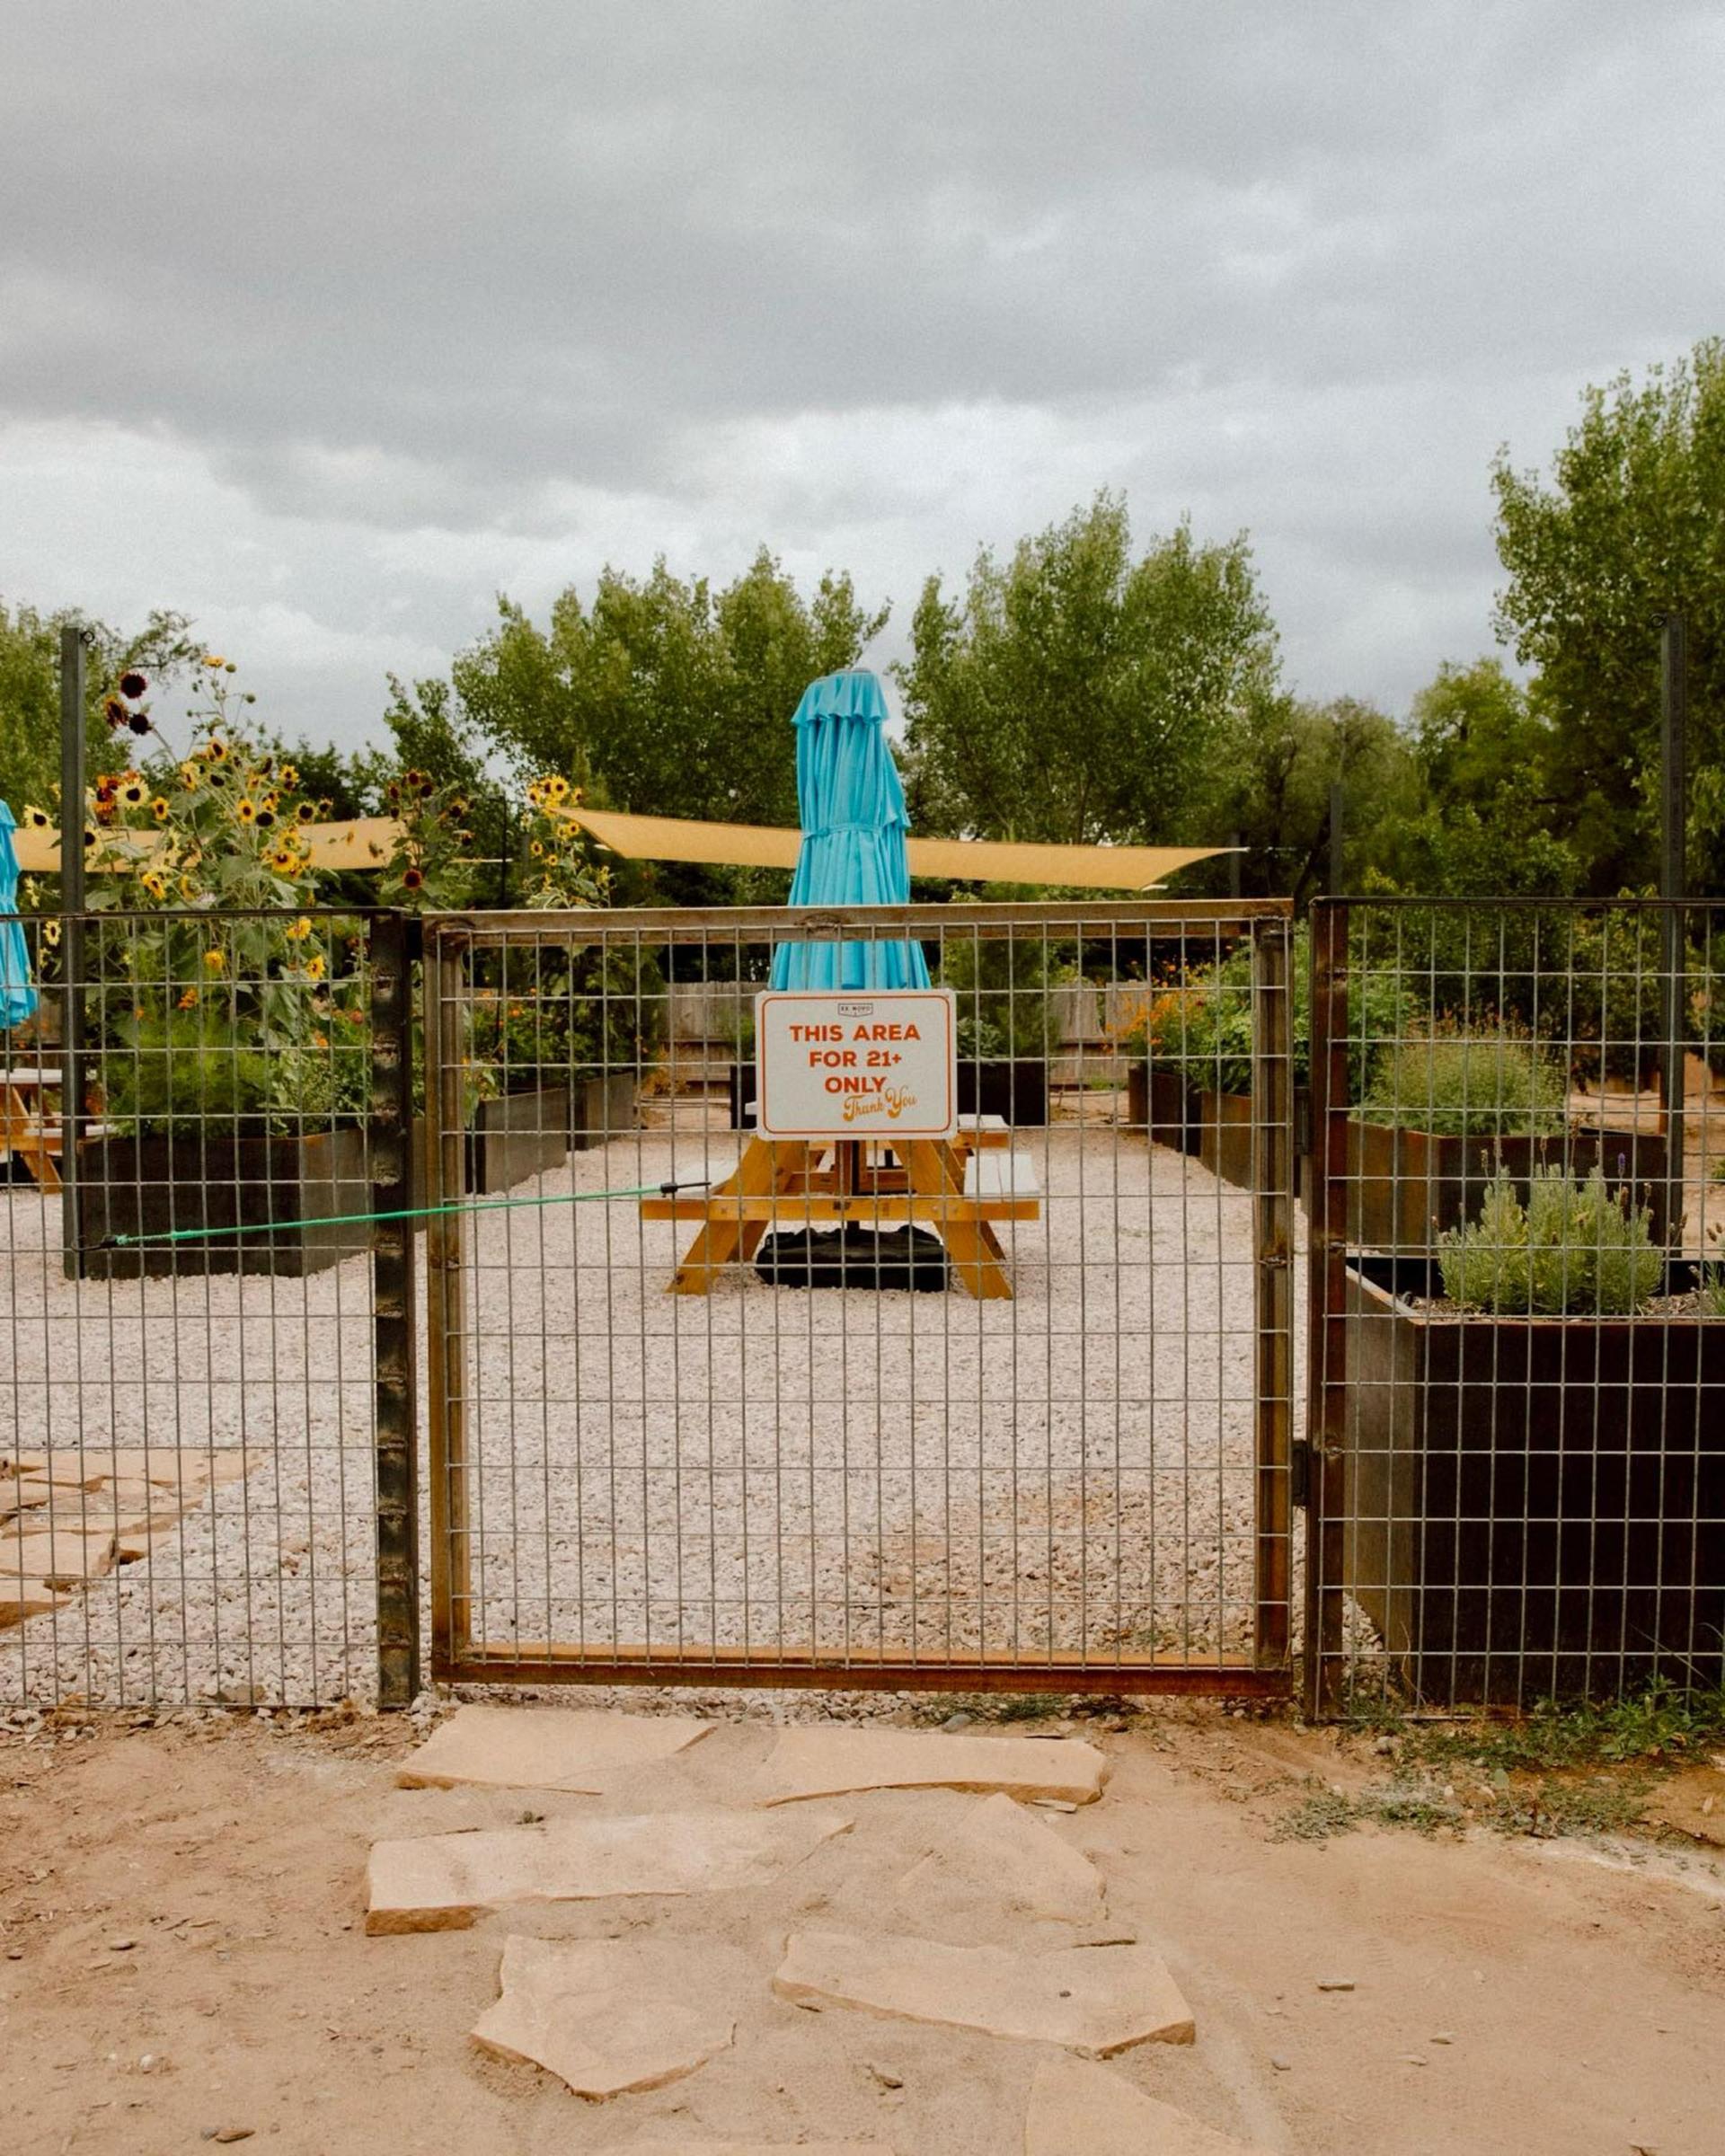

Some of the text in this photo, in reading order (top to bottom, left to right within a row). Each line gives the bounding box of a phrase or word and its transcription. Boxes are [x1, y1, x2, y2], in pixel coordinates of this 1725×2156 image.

[790, 1023, 921, 1042] THIS AREA
[809, 1050, 902, 1067] FOR 21+
[825, 1076, 888, 1093] ONLY
[843, 1085, 917, 1122] Thank You
